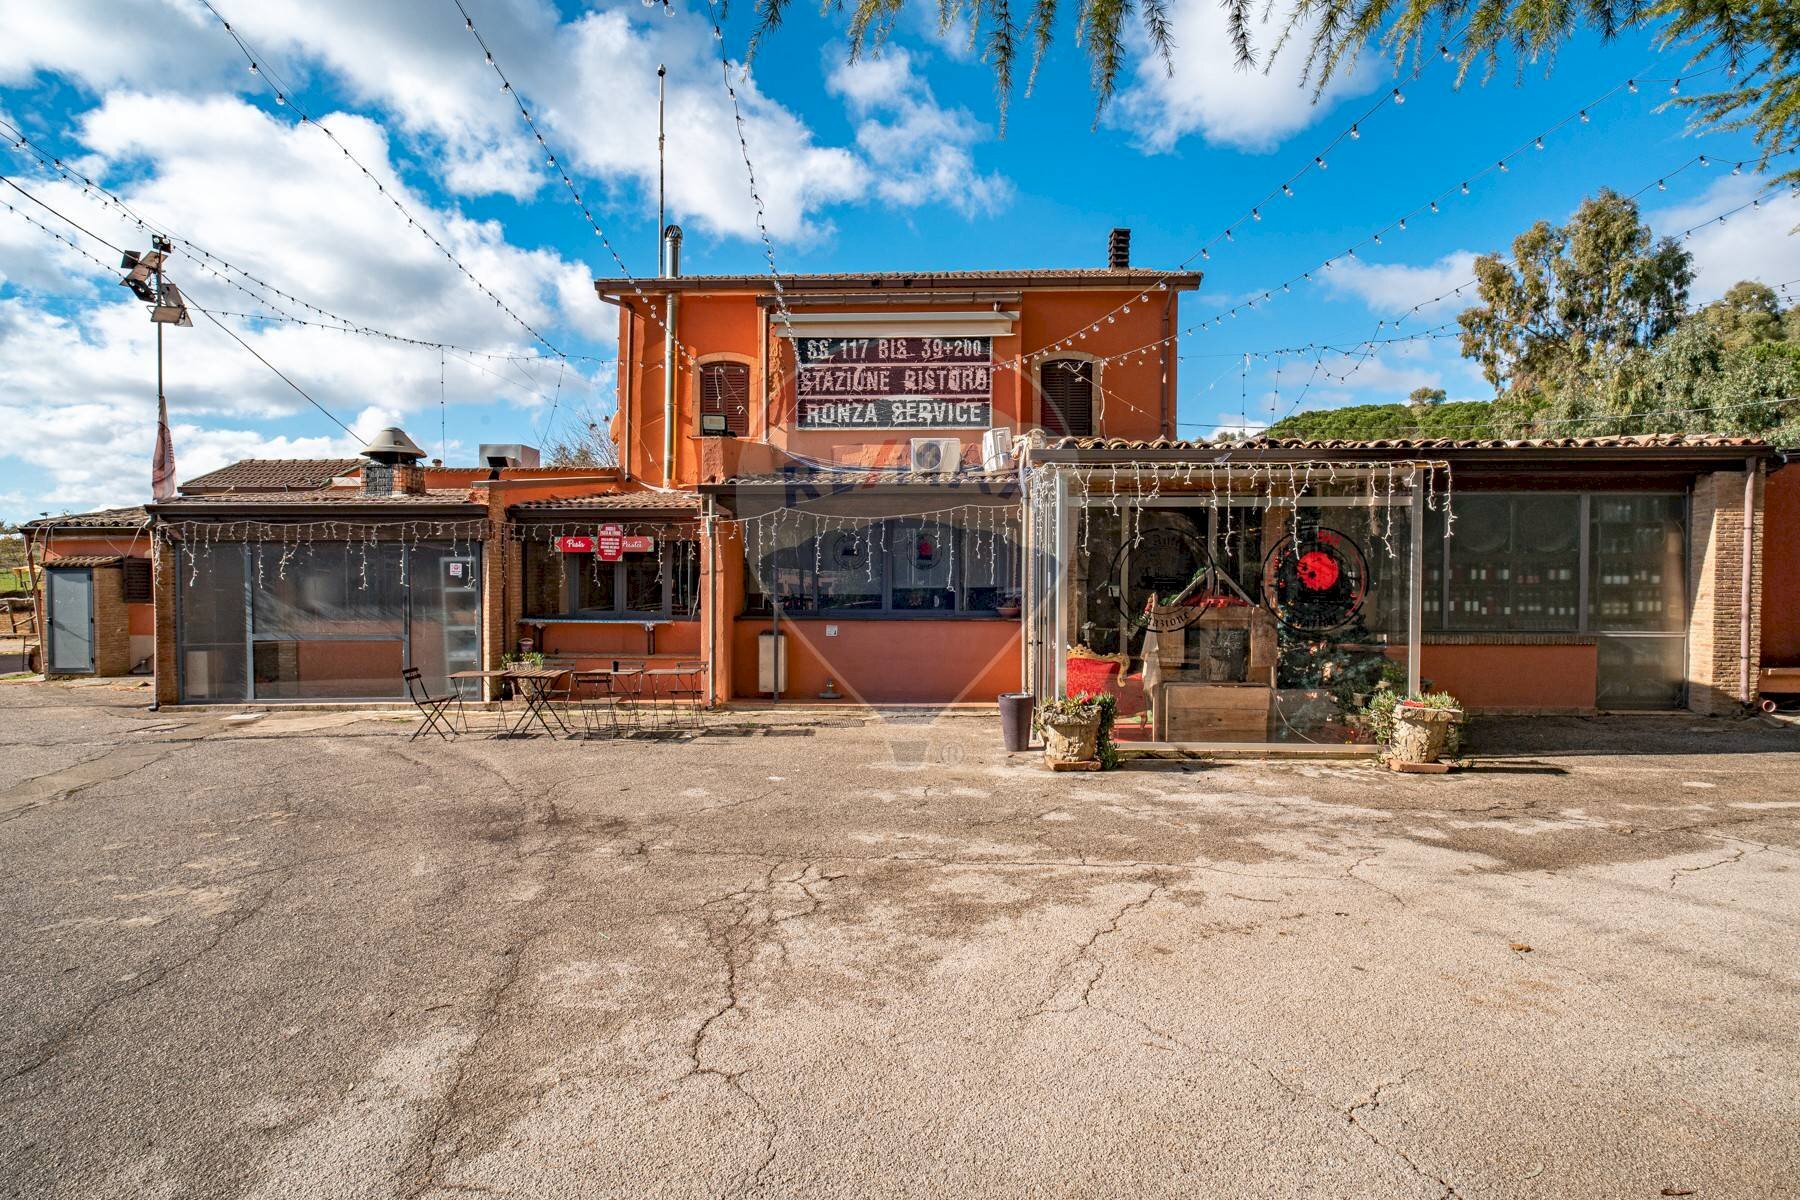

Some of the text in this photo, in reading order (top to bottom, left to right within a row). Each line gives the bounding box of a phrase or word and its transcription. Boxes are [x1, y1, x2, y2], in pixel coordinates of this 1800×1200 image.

[840, 339, 869, 359] 117
[921, 338, 982, 359] 39+200
[800, 368, 988, 391] STAZIONE RISTORO
[890, 402, 982, 424] SERVICE
